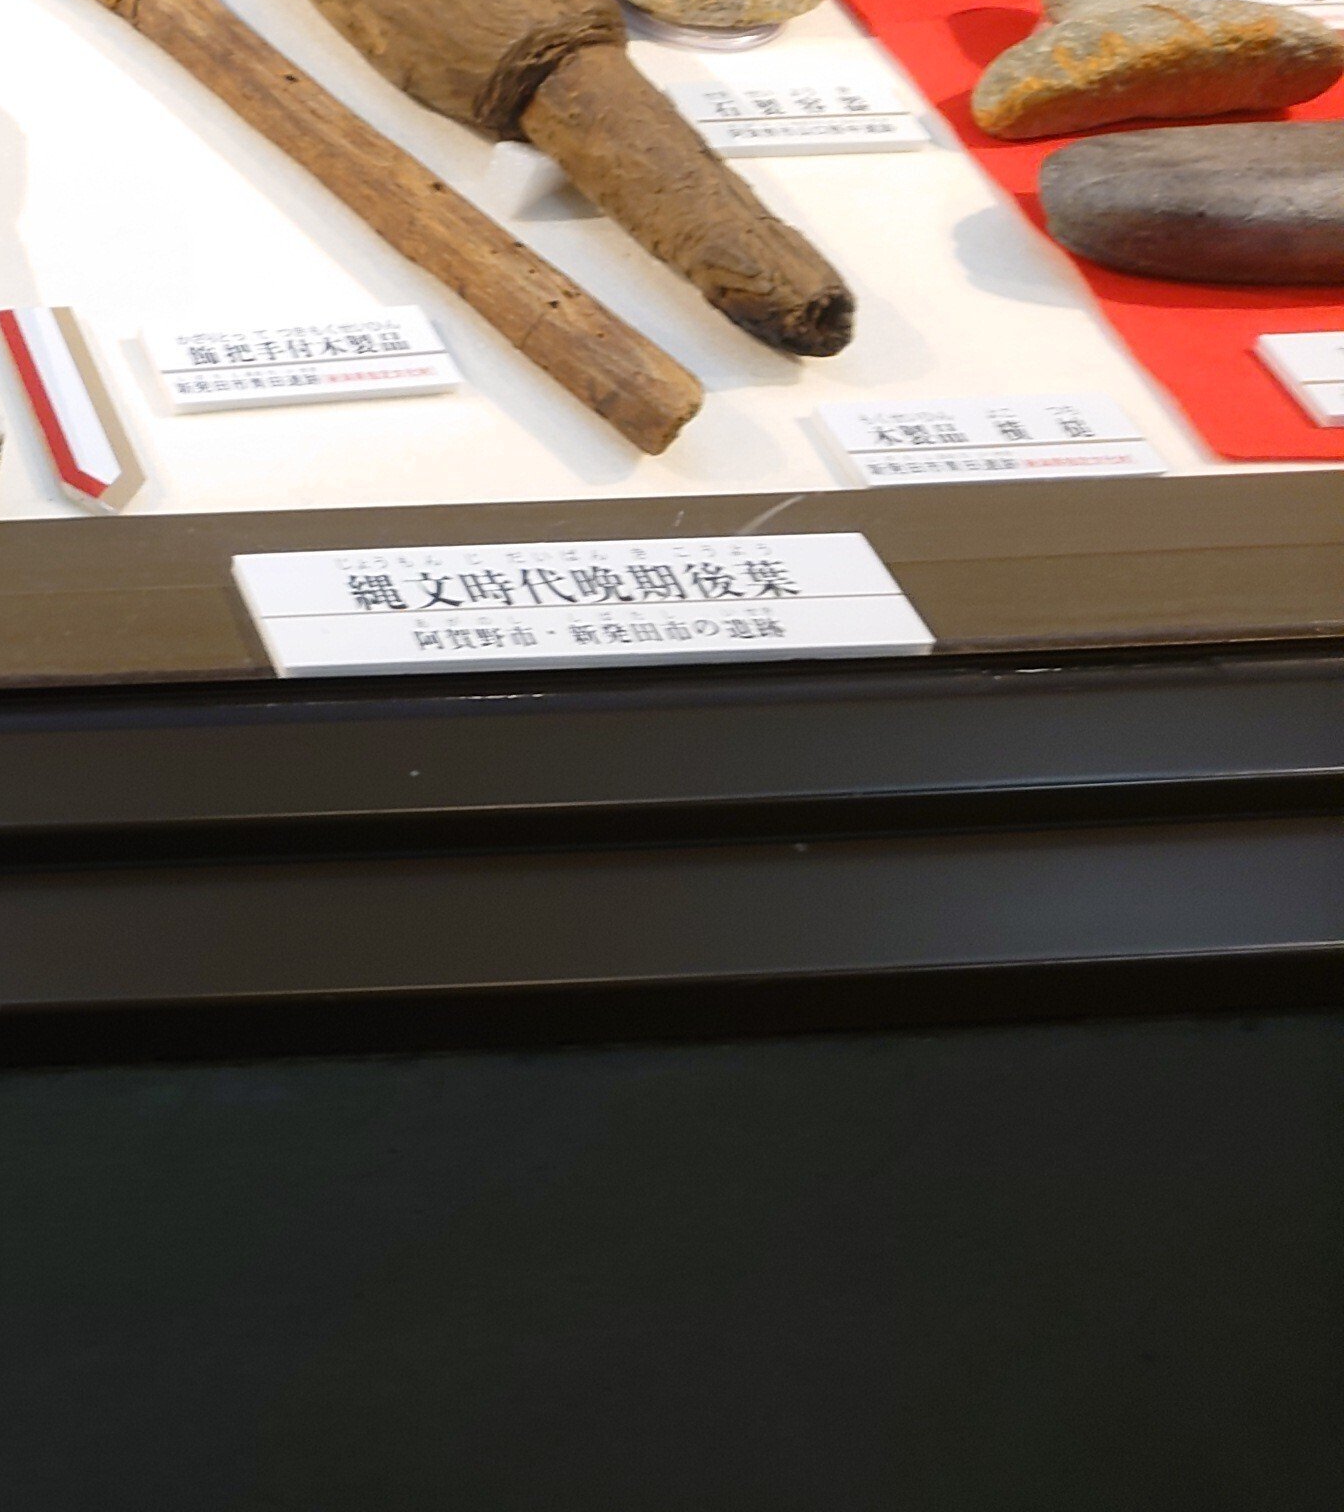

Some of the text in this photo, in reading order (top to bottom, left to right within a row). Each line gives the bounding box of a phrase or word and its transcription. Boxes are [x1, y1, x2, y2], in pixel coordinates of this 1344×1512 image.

[348, 559, 802, 612] 縄文時代晩期後葉
